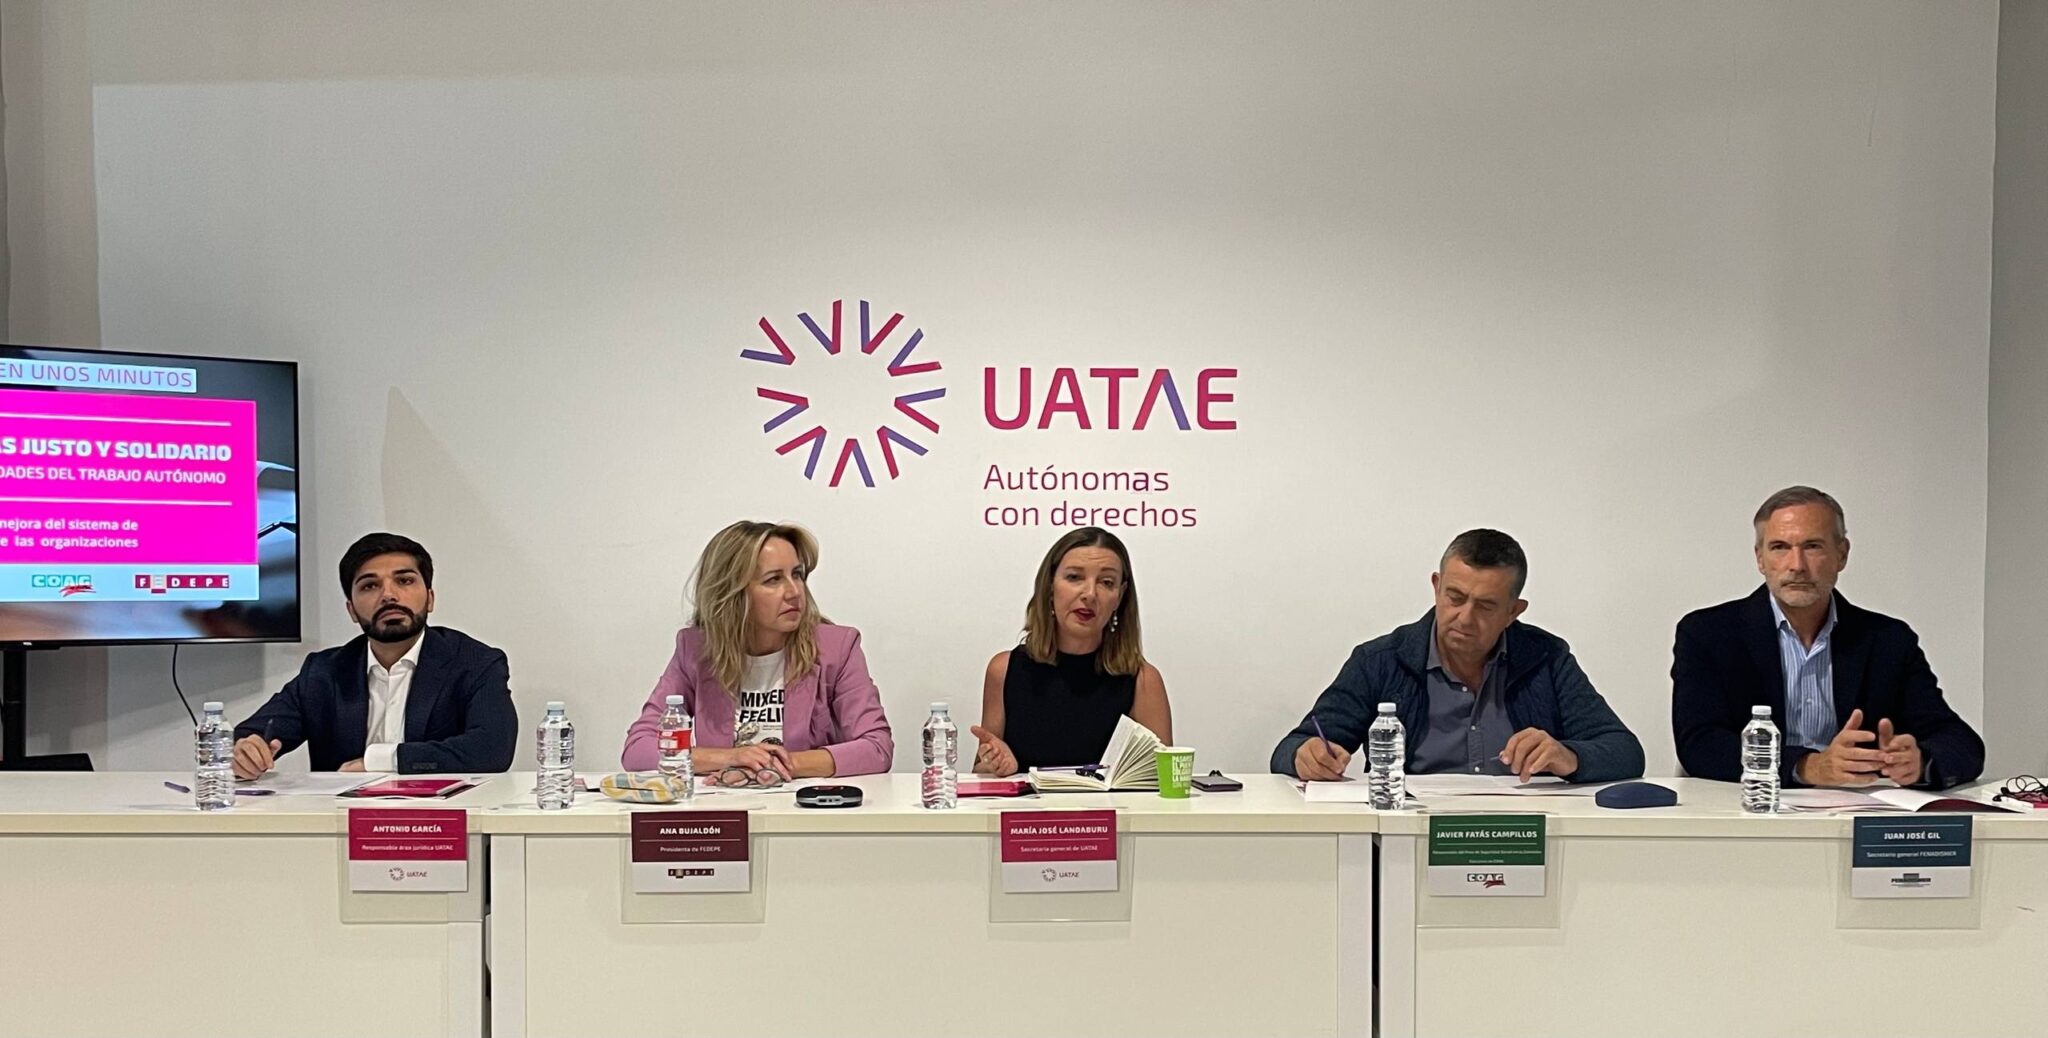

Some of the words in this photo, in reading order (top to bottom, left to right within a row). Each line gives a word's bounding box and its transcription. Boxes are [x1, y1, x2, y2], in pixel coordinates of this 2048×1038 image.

[31, 364, 90, 382] UNOS
[97, 367, 193, 388] MINUTOS
[984, 367, 1238, 431] UATAE
[21, 438, 92, 457] JUSTO
[95, 441, 110, 457] Y
[114, 442, 232, 461] SOLIDARIO
[48, 468, 76, 481] DEL
[78, 468, 141, 482] TRABAJO
[144, 468, 226, 484] AUTÓNOMO
[983, 464, 1169, 491] Autónomas
[984, 506, 1039, 526] con
[1050, 500, 1197, 527] derechos
[45, 518, 65, 530] del
[69, 519, 119, 531] sistema
[122, 519, 139, 531] de
[15, 536, 34, 547] las
[41, 536, 139, 550] organizaciones
[33, 575, 92, 588] COAG
[137, 575, 230, 588] FEDEPE
[741, 689, 784, 707] MIXED
[739, 708, 784, 723] FEELI
[373, 825, 410, 833] ANTONIO
[411, 824, 442, 833] GARCÍA
[679, 826, 721, 835] BUJALDÓN
[1010, 826, 1037, 835] MARÍA
[1038, 826, 1057, 834] JOSÉ
[1059, 826, 1108, 834] LANDABURU
[1436, 831, 1464, 839] JAVIER
[1465, 829, 1490, 839] FATÁS
[1491, 830, 1538, 838] CAMPILLOS
[1883, 832, 1905, 840] JUAN
[1906, 830, 1926, 840] JOSÉ
[1927, 832, 1941, 840] GIL
[1467, 873, 1504, 882] COAG
